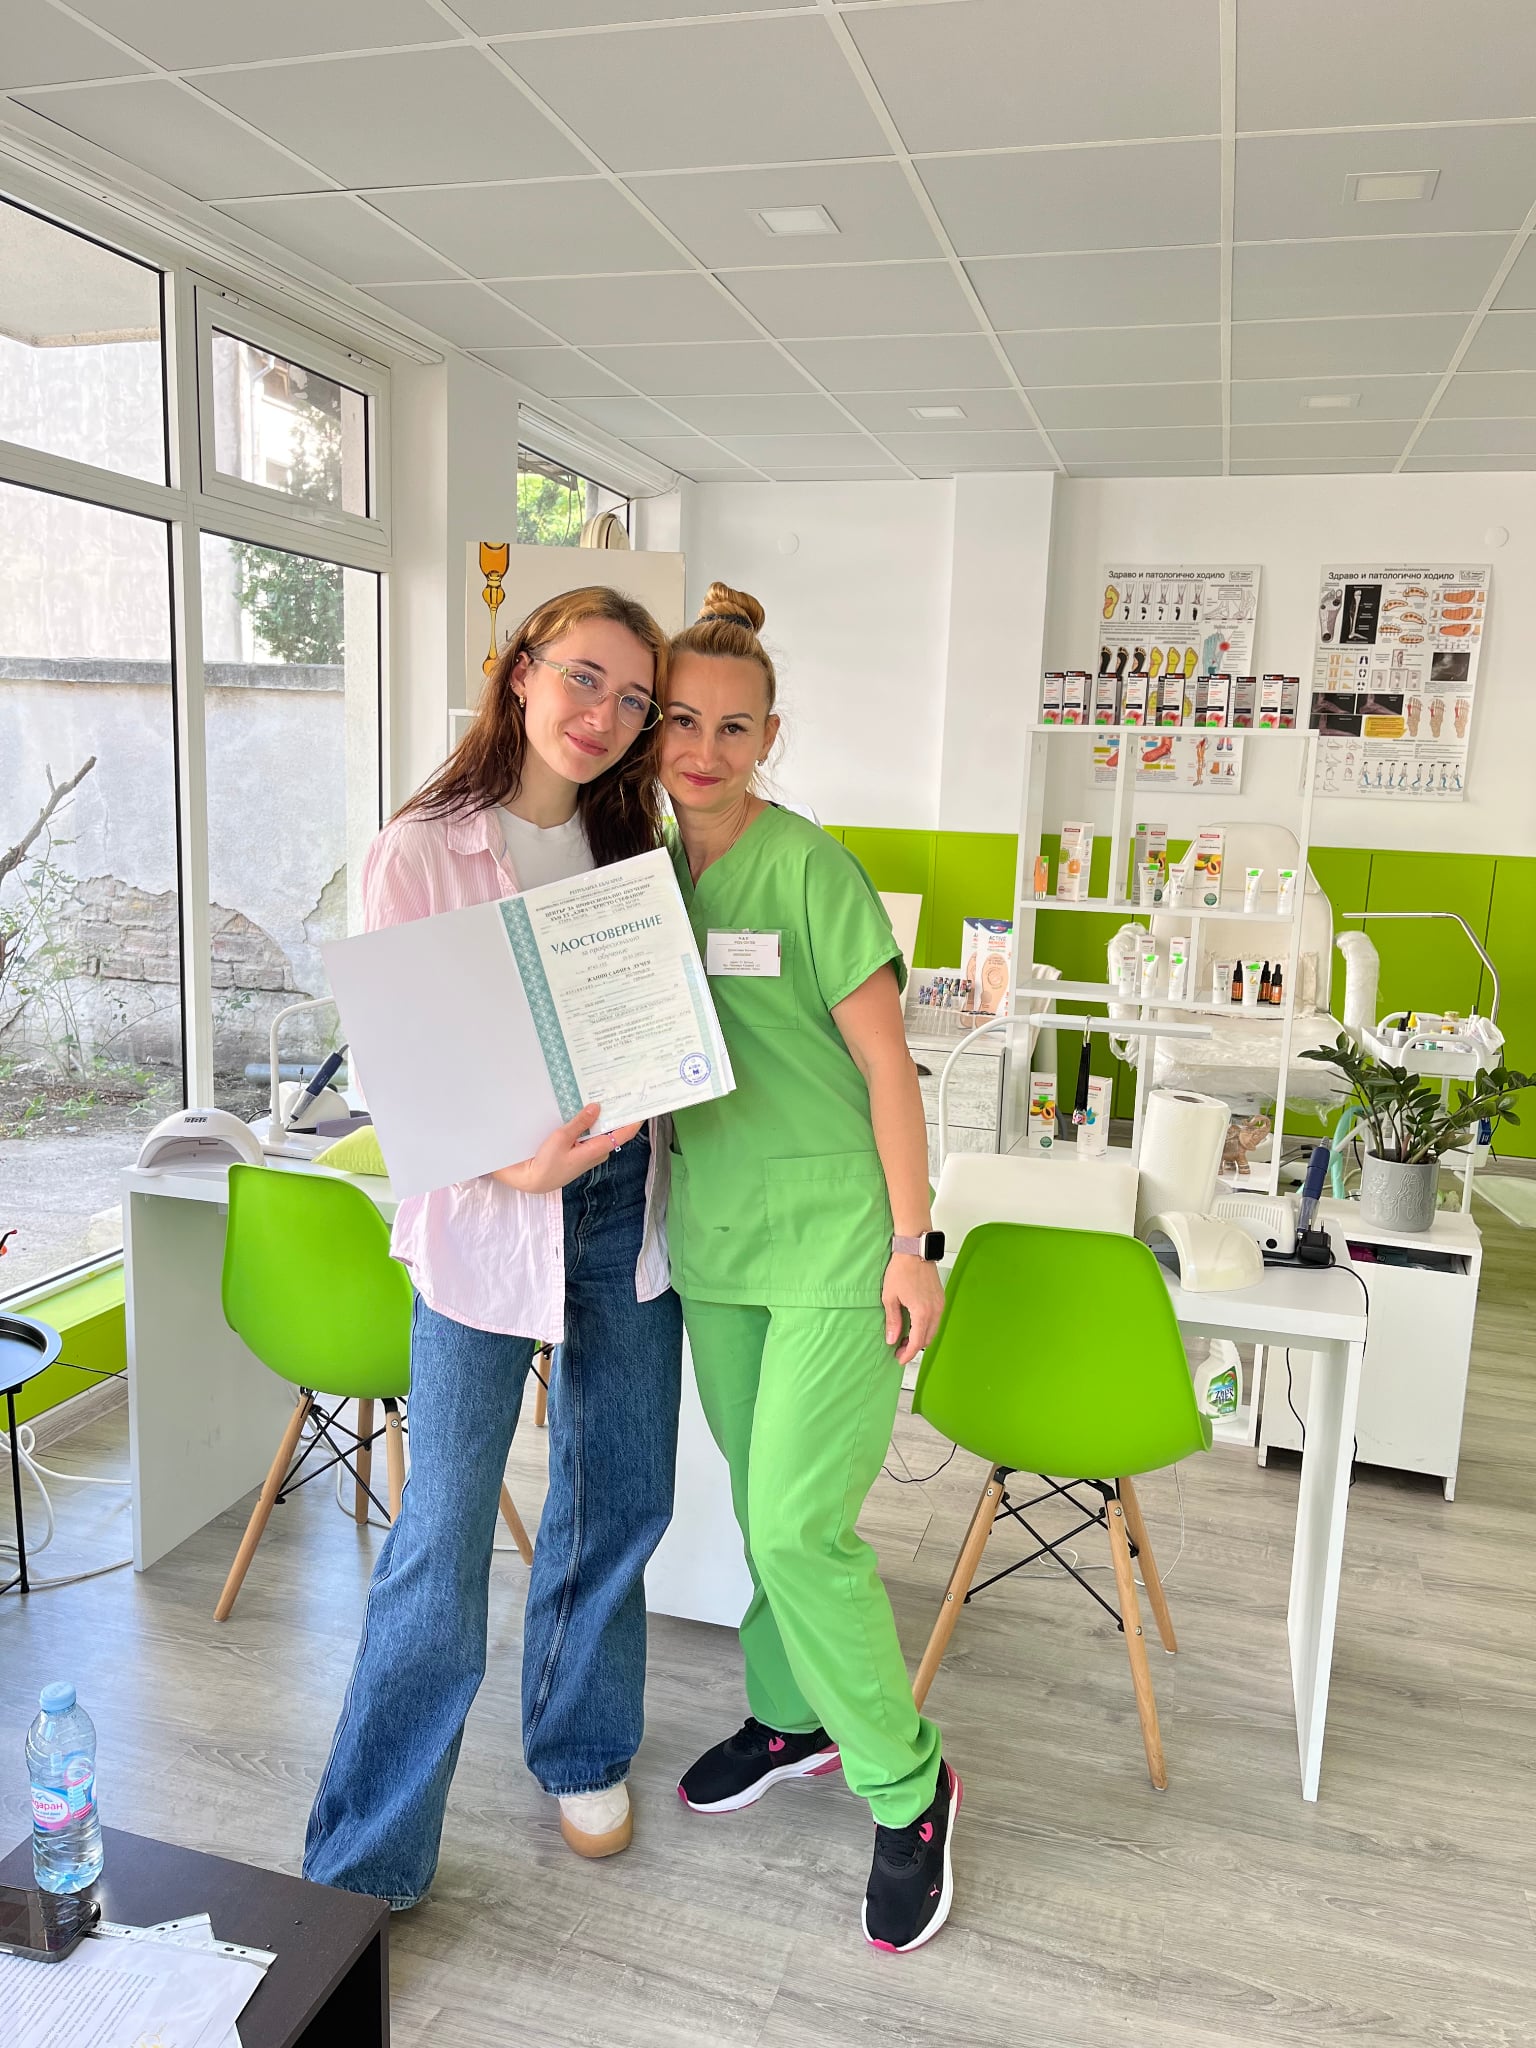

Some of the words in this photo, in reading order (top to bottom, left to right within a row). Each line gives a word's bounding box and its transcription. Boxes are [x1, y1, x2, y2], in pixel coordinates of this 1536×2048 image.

[1108, 570, 1137, 579] Здраво
[1145, 571, 1195, 579] патологично
[1196, 571, 1226, 579] ходило
[1328, 571, 1359, 580] Здраво
[1368, 572, 1422, 580] патологично
[1423, 572, 1455, 580] ходило
[551, 914, 663, 955] УДОСТОВЕРЕНИЕ
[589, 935, 640, 956] професионално
